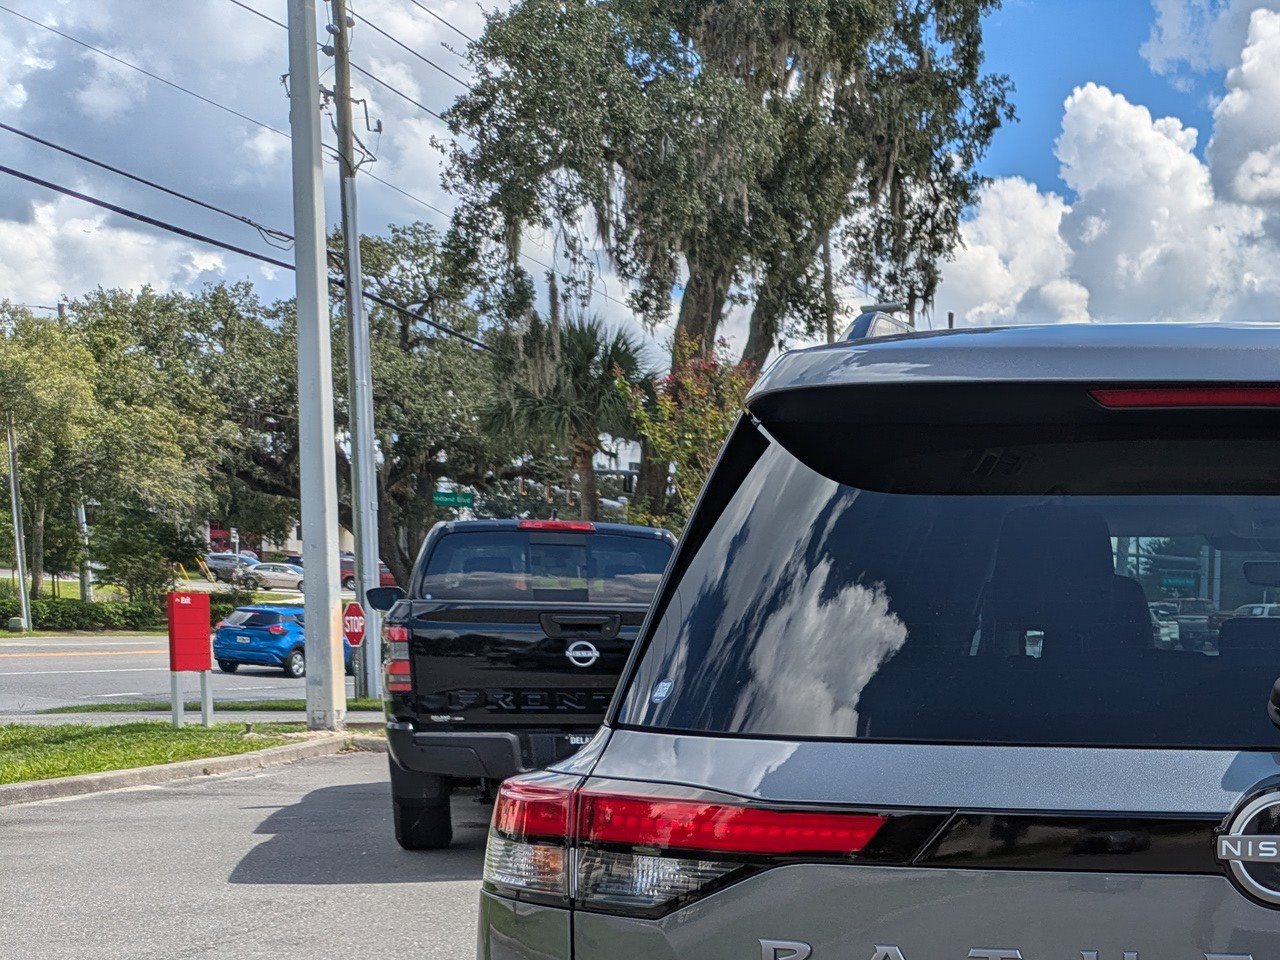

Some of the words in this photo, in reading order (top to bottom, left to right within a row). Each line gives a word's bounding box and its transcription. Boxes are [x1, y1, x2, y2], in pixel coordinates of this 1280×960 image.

[180, 596, 191, 605] Exit
[344, 616, 365, 633] STOP
[569, 736, 594, 746] DELA
